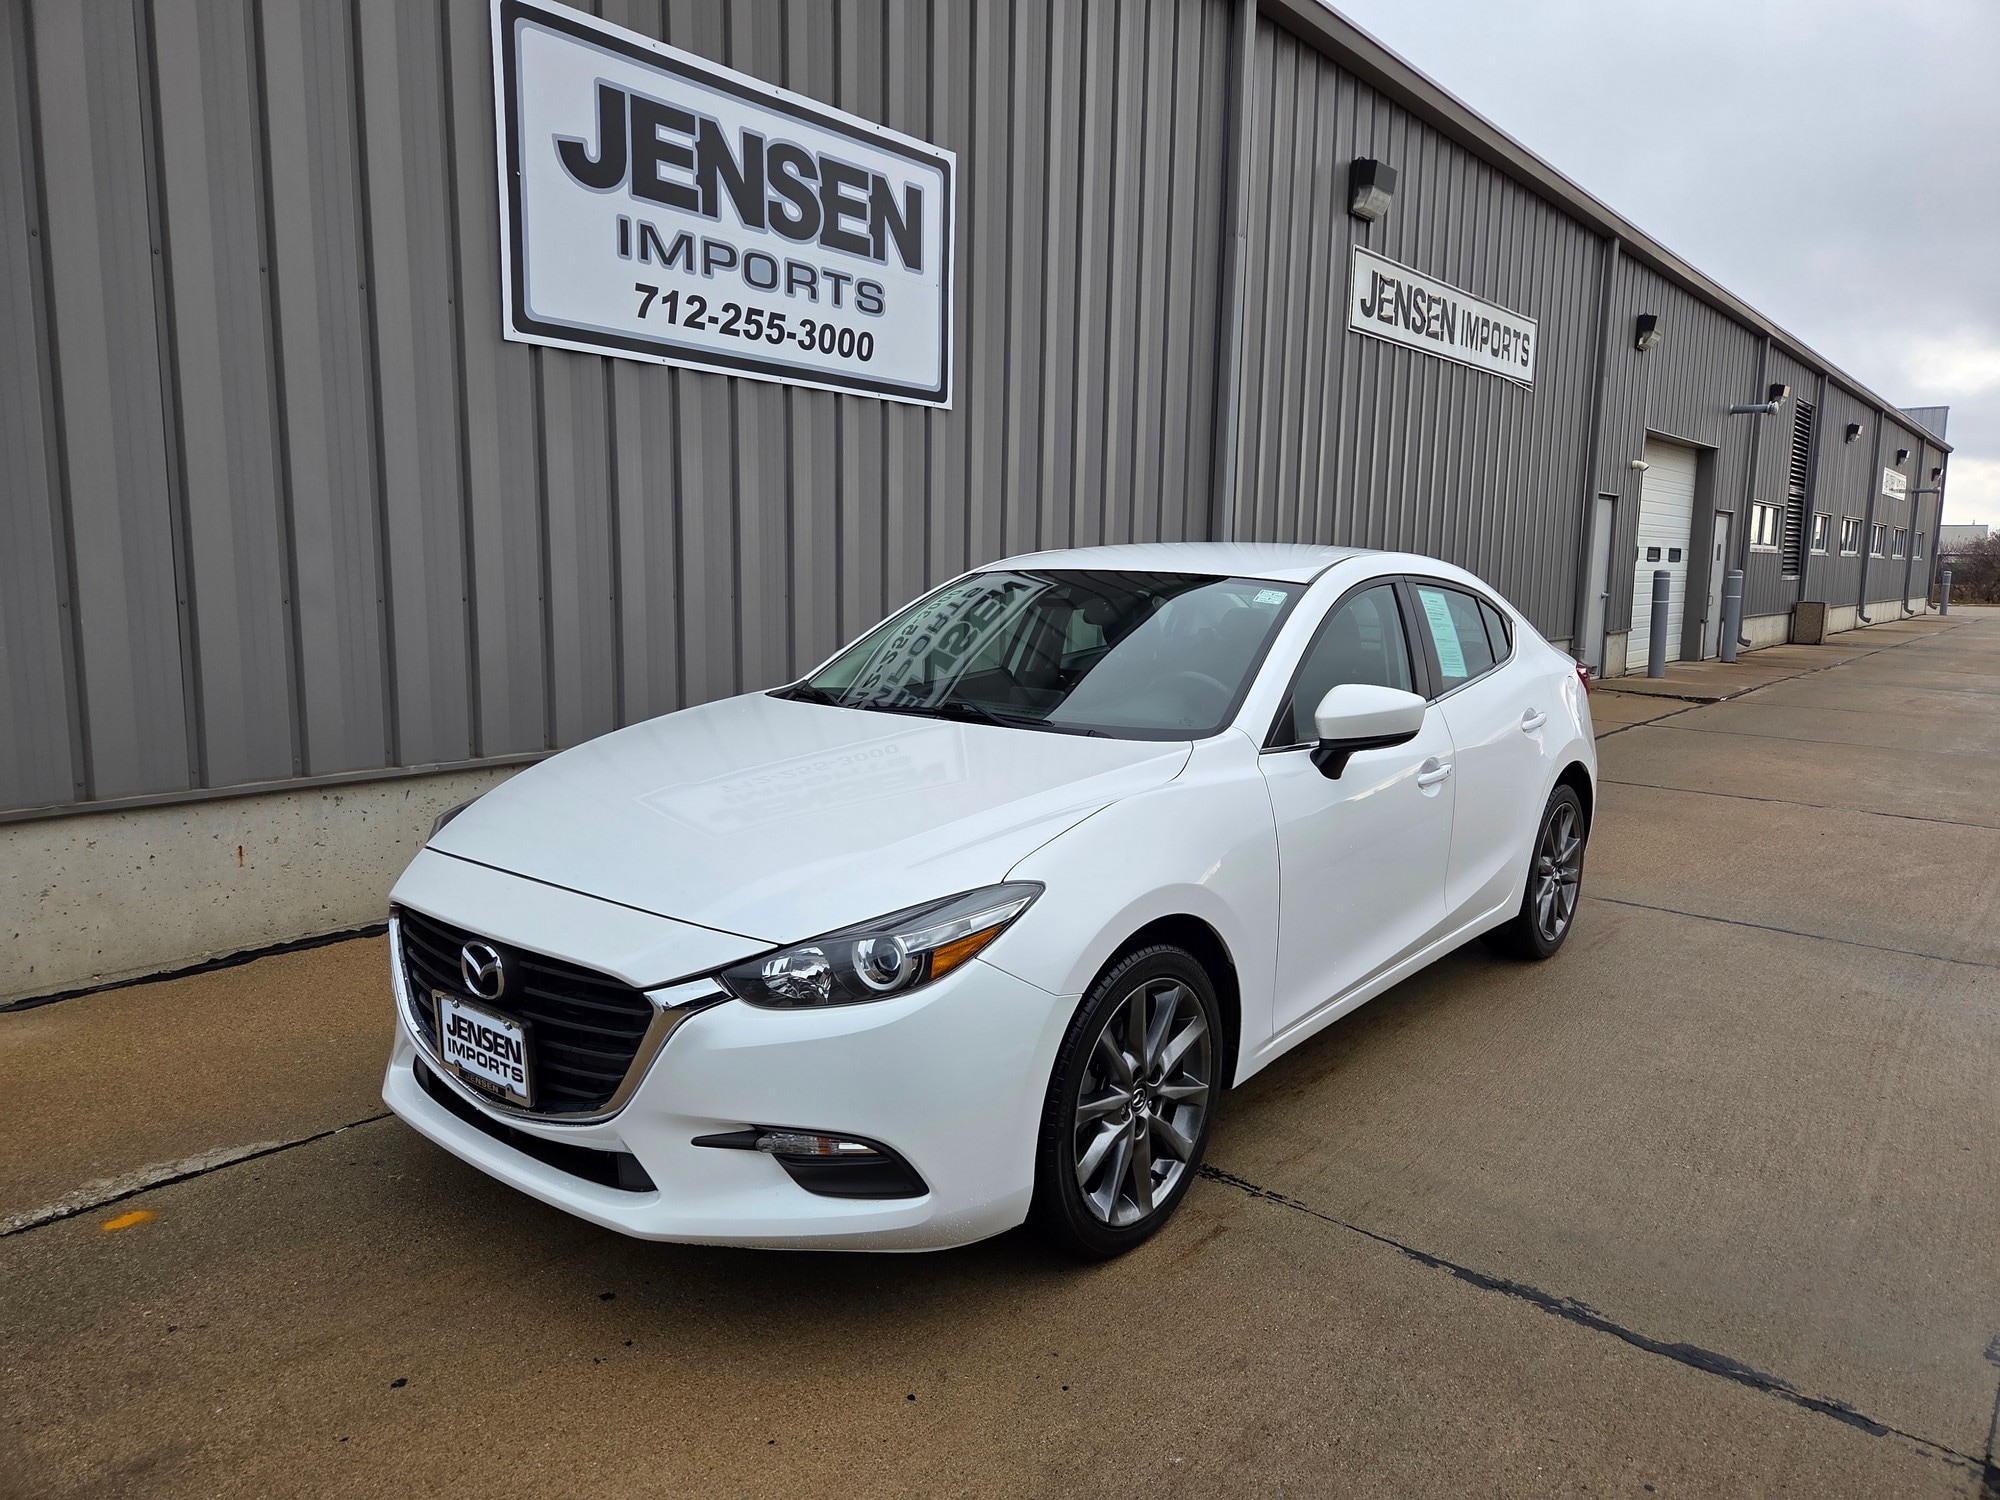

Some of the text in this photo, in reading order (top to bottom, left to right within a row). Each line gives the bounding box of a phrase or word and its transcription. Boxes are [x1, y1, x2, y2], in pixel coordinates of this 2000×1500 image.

[553, 77, 924, 273] JENSEN
[616, 213, 886, 317] IMPORTS
[633, 282, 875, 362] 712-255-3000
[1360, 269, 1530, 368] JENSEN IMPORTS
[446, 1013, 523, 1065] JENSEN
[447, 1036, 524, 1084] IMPORTS
[465, 1073, 500, 1093] JENSEN
